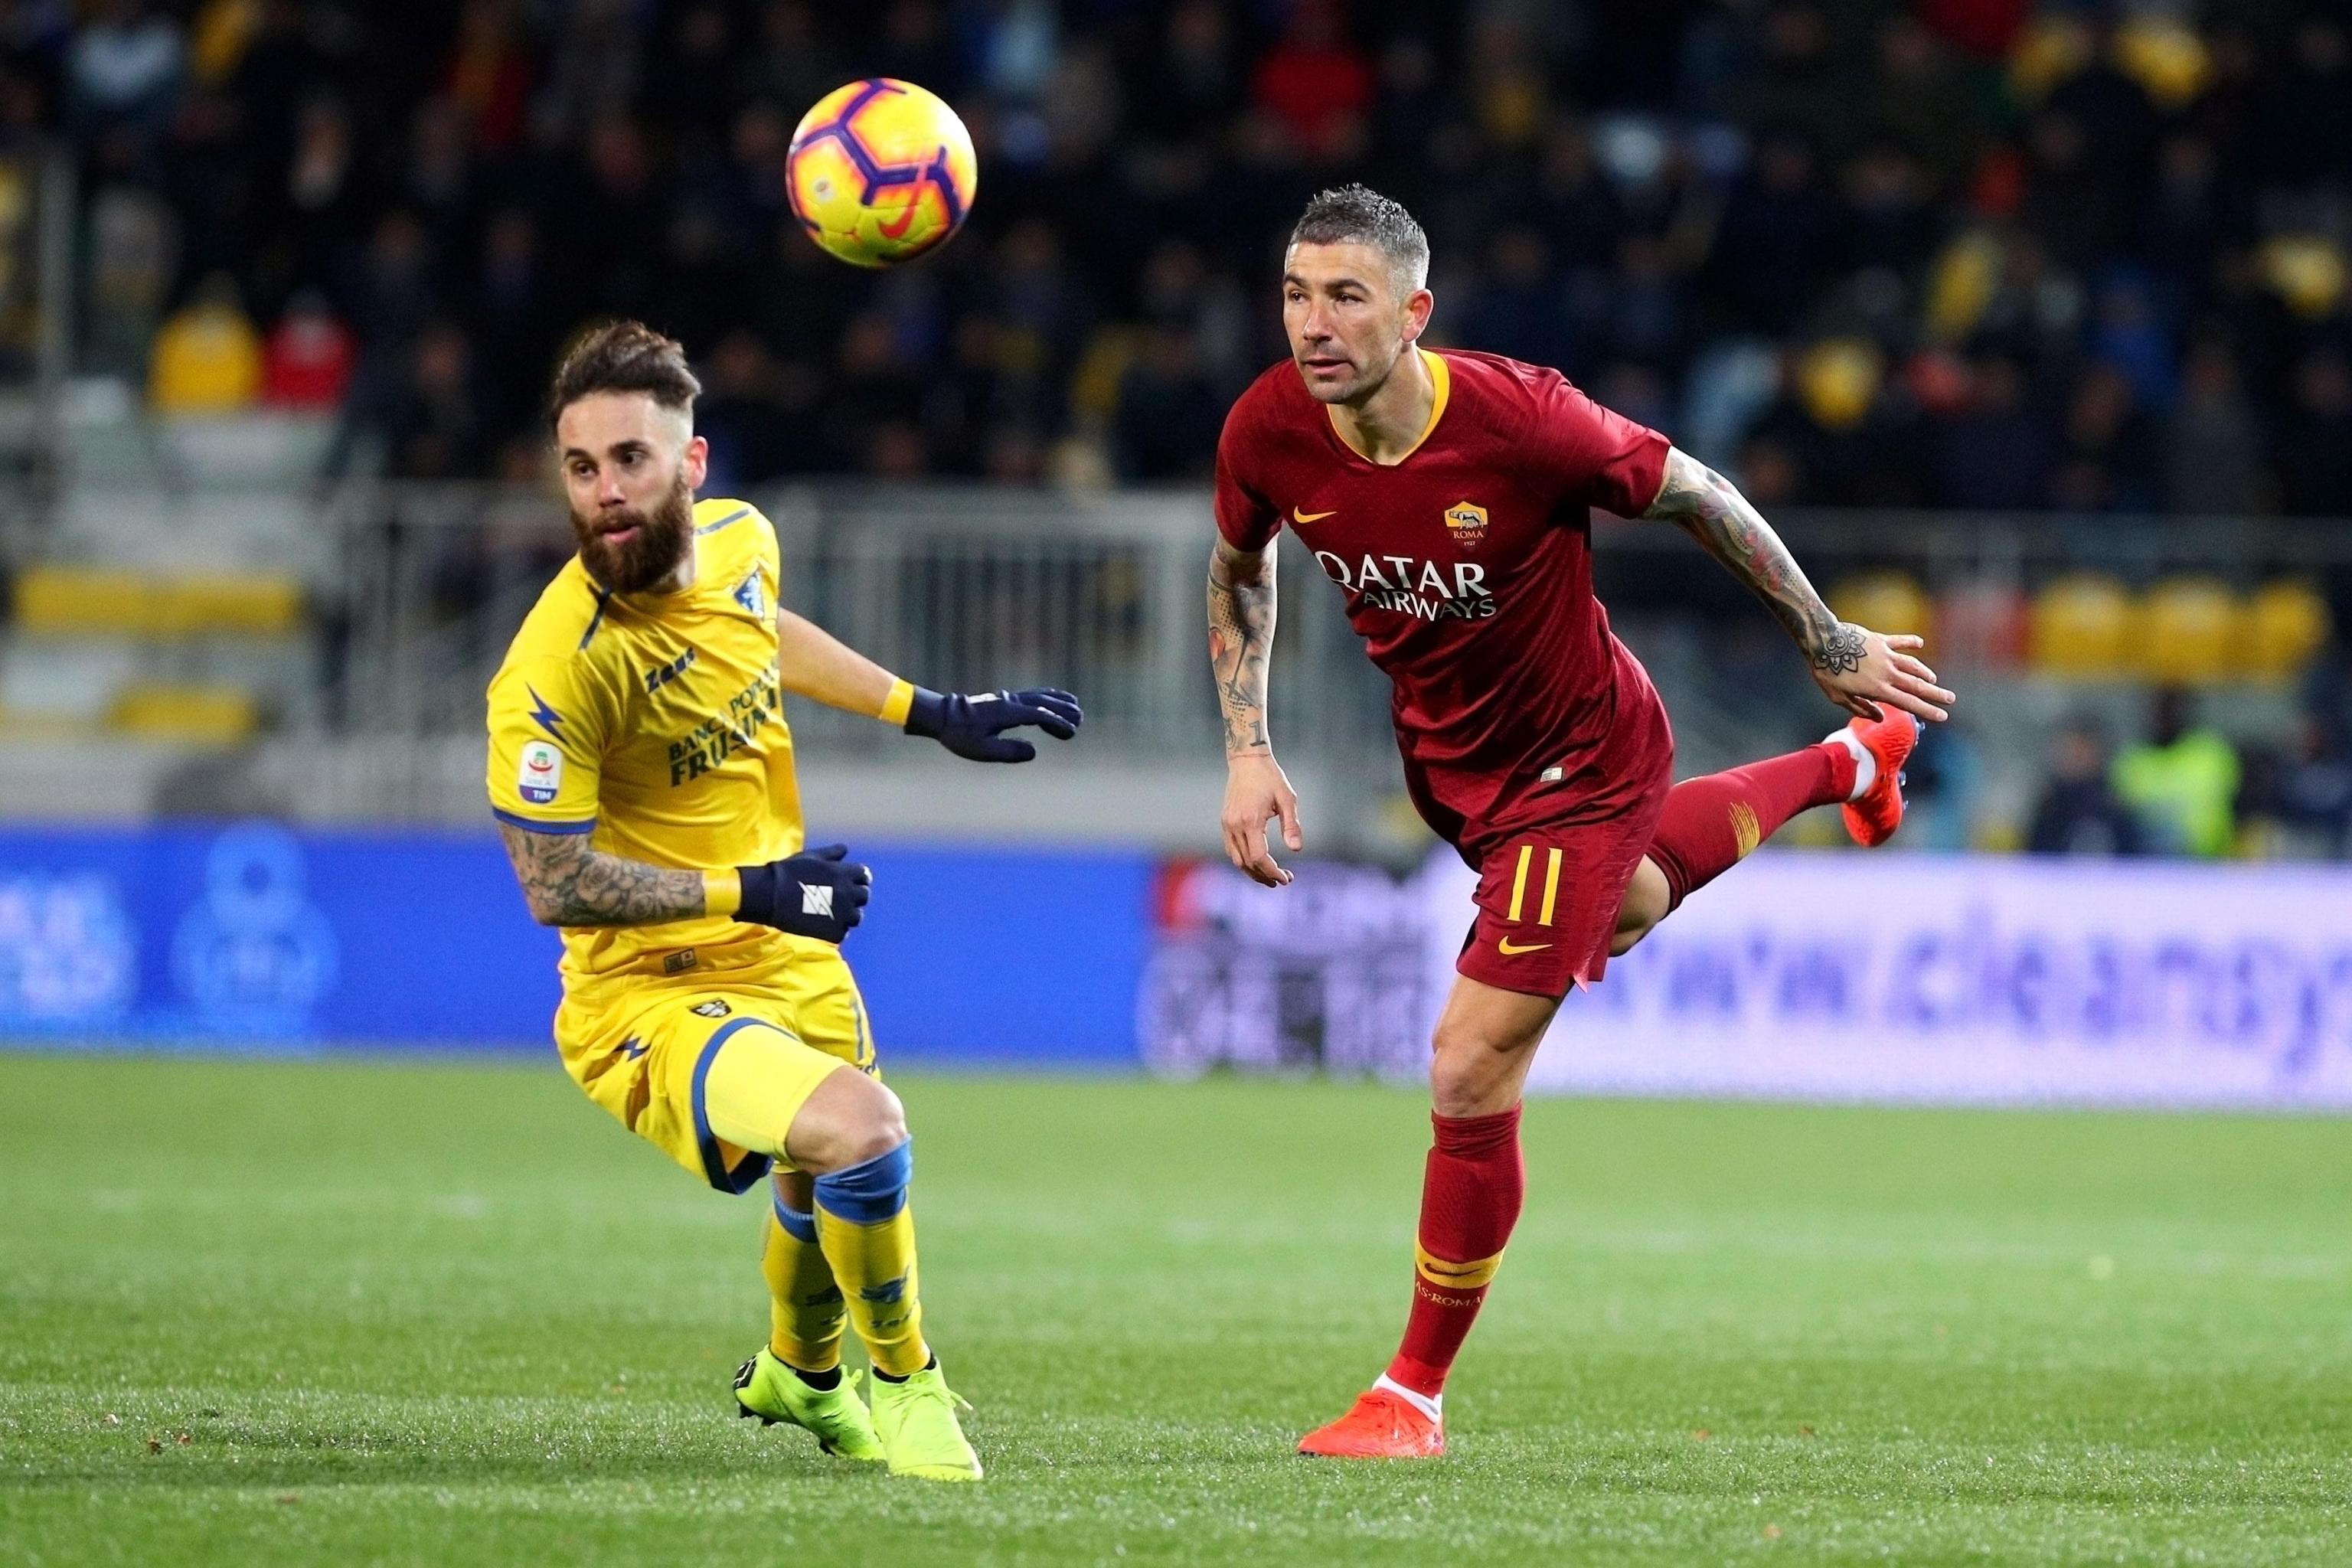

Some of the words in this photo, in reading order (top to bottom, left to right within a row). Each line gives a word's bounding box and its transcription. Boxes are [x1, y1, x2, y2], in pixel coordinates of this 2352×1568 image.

[1453, 530, 1484, 539] ROMA
[1315, 550, 1492, 599] QATAR
[1364, 591, 1497, 622] AIRWAYS
[533, 789, 552, 801] TIM
[1506, 844, 1563, 927] 11
